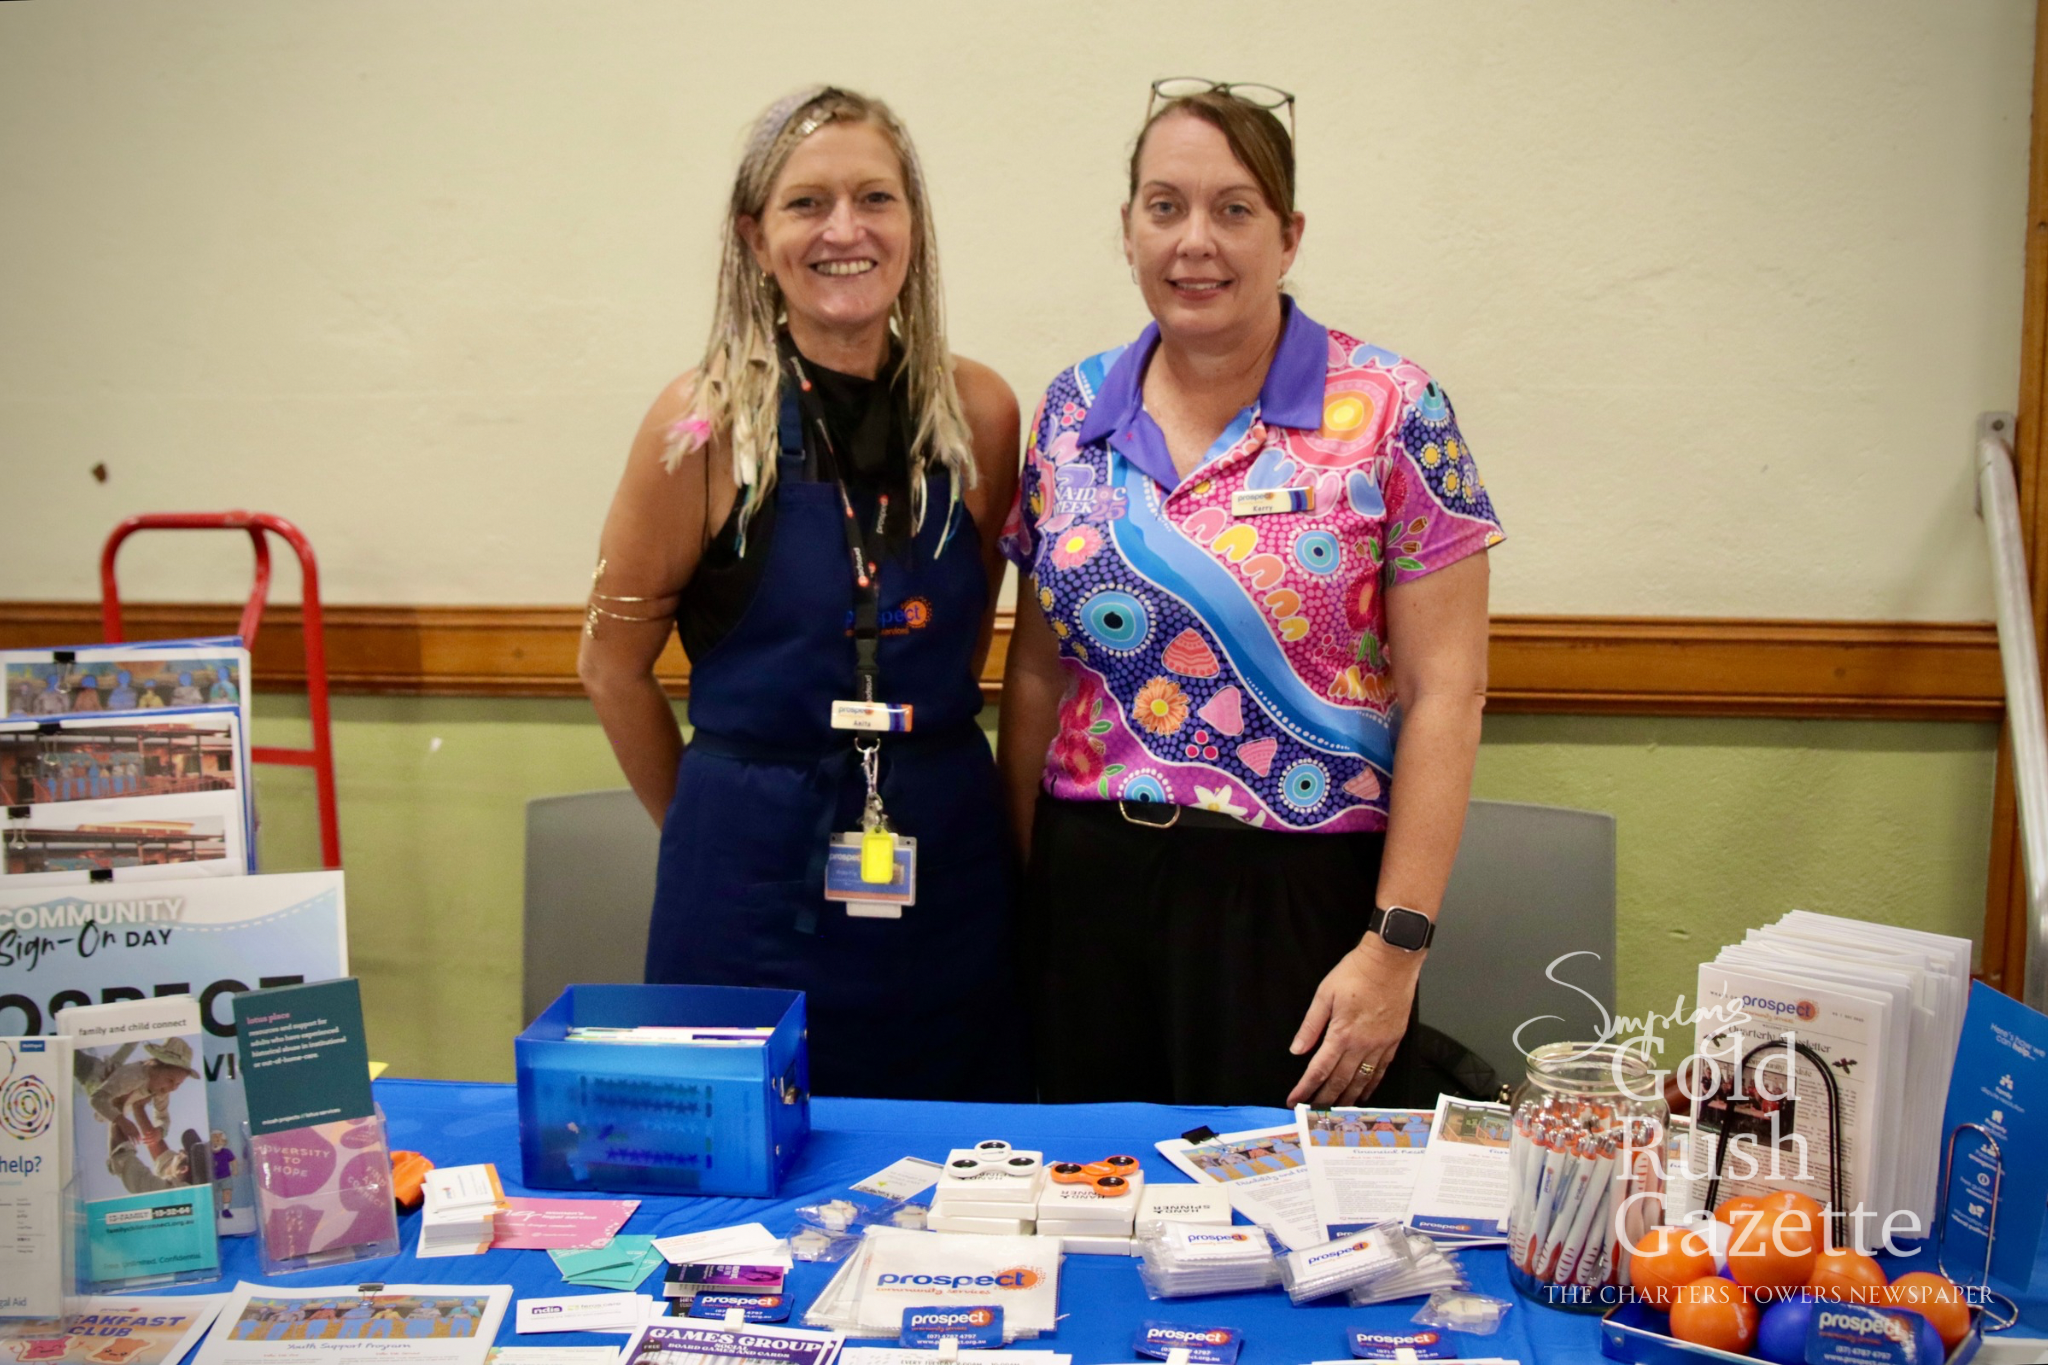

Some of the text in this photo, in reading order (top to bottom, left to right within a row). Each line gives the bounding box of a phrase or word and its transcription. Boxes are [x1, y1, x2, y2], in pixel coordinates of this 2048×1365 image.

[0, 899, 183, 929] COMMUNITY
[125, 928, 172, 947] DAY
[1742, 995, 1811, 1017] prospect
[246, 1012, 291, 1025] lotus place
[280, 1023, 292, 1032] and
[293, 1021, 317, 1031] support
[317, 1018, 327, 1026] for
[78, 1019, 187, 1037] family and child connect
[1728, 1025, 1775, 1042] Quarterly
[250, 1026, 340, 1048] adults who have experienced
[1996, 1034, 2012, 1048] can
[251, 1046, 281, 1058] historical
[282, 1045, 301, 1054] abuse
[309, 1036, 347, 1049] institutional
[284, 1157, 302, 1165] TO
[273, 1166, 308, 1178] HOPE
[1419, 1220, 1465, 1232] prospect
[1187, 1233, 1244, 1243] prospect
[1308, 1242, 1365, 1265] prospect
[877, 1271, 1026, 1289] prospect
[876, 1287, 992, 1295] community services
[701, 1295, 773, 1307] prospect
[532, 1305, 562, 1316] ndis
[911, 1311, 986, 1326] prospect
[1819, 1312, 1902, 1337] prospect
[68, 1326, 132, 1337] CLUB
[1147, 1328, 1221, 1342] prospect
[649, 1328, 822, 1353] GAMES GROUP
[1356, 1333, 1431, 1346] prospect
[320, 1342, 362, 1352] Support
[366, 1342, 412, 1351] Program
[702, 1345, 736, 1354] GAMES
[757, 1350, 791, 1358] CARDS
